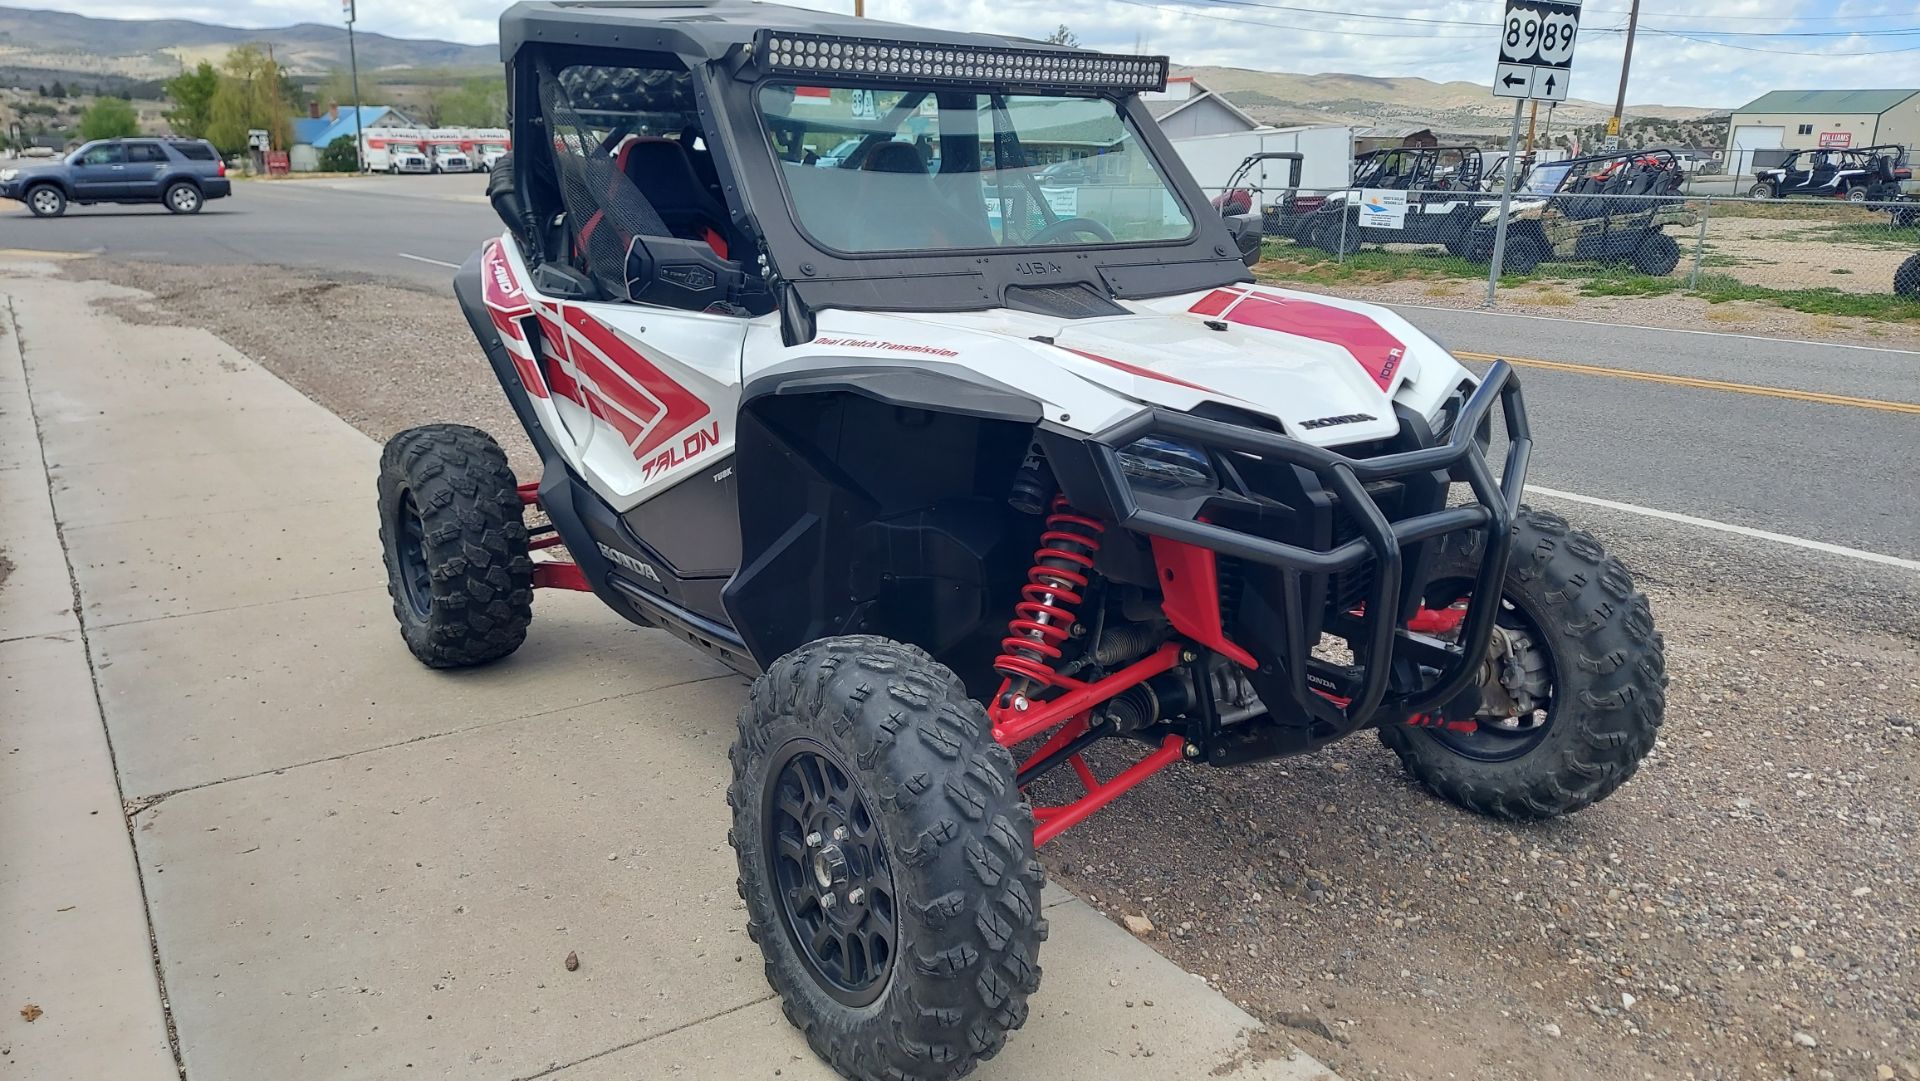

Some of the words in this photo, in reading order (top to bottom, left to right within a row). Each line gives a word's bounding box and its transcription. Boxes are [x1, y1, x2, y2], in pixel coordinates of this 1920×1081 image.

[1506, 18, 1537, 48] 89
[1543, 23, 1573, 52] 89
[1821, 133, 1850, 141] WILLIAMS
[1018, 261, 1062, 276] USA
[814, 337, 842, 346] Dual
[840, 338, 878, 349] Clutch
[876, 341, 960, 358] Transmission
[1298, 413, 1378, 431] HONDA
[642, 420, 720, 484] TALON
[596, 541, 661, 583] HONDA
